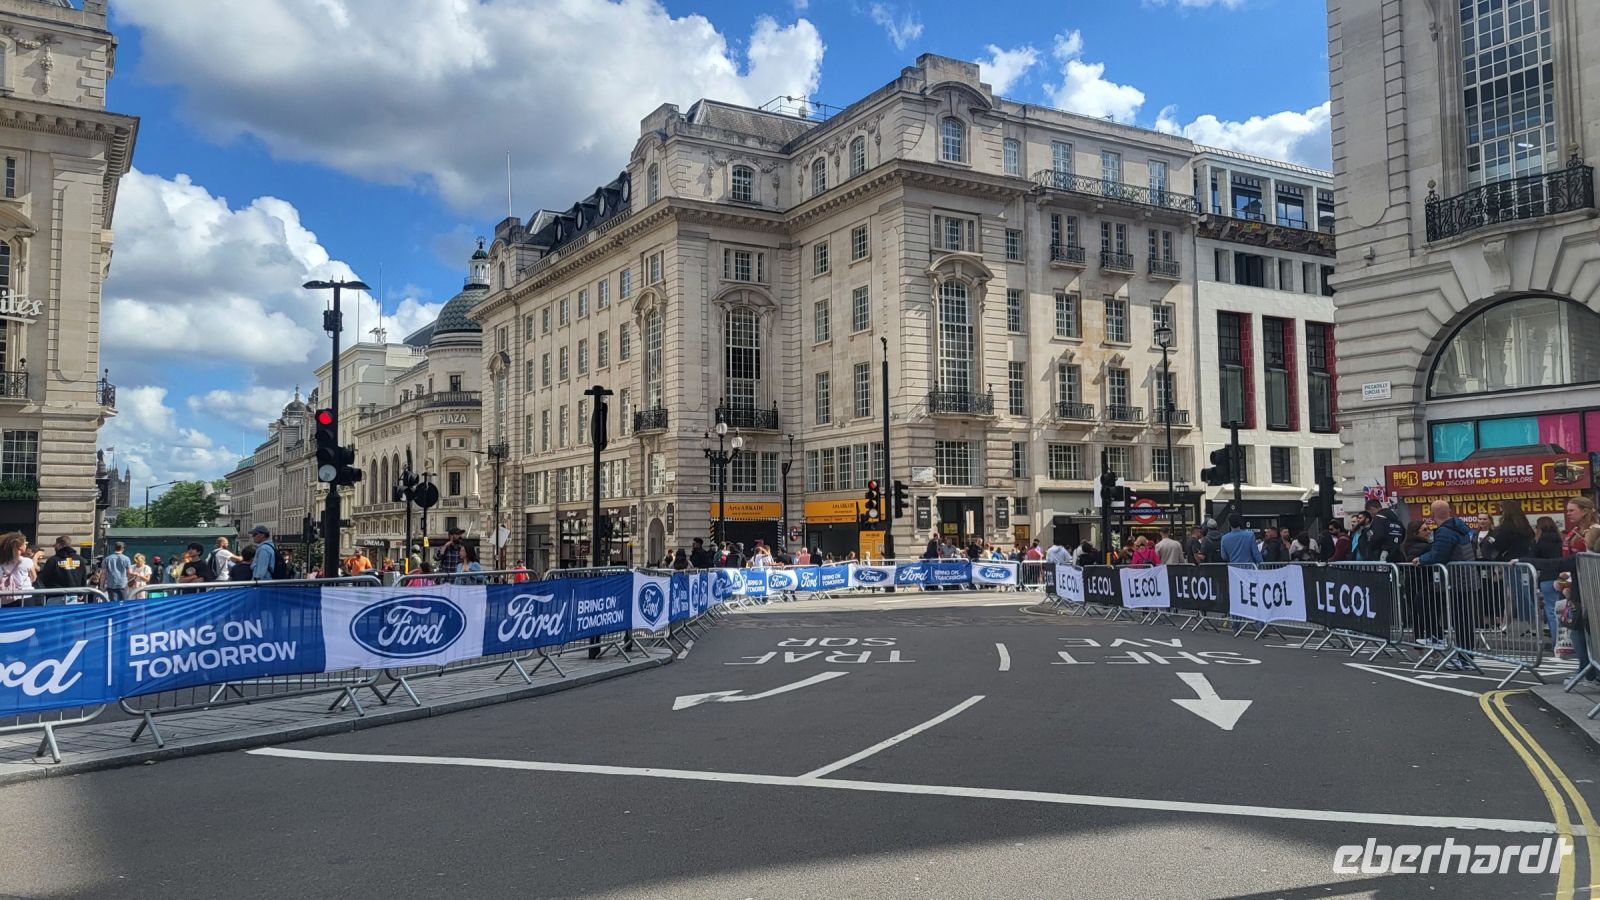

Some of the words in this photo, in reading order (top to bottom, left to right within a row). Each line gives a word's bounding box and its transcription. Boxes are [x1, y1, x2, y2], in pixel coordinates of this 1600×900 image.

[0, 289, 43, 316] ites
[439, 414, 467, 424] PLAZA
[1393, 471, 1407, 480] BIG
[1421, 470, 1444, 481] BUY
[1446, 467, 1497, 479] TICKETS
[1499, 465, 1534, 476] HERE
[1505, 476, 1534, 484] EXPLORE
[1453, 501, 1497, 515] TICKE
[1520, 499, 1565, 513] HERE
[770, 574, 788, 588] Ford
[800, 571, 818, 588] Ford
[860, 570, 882, 581] Ford
[900, 566, 928, 581] Ford
[985, 568, 1006, 578] Ford
[1059, 573, 1066, 590] LE
[1066, 574, 1079, 593] COL
[1088, 576, 1097, 594] LE
[1097, 576, 1114, 596] COL
[1128, 578, 1140, 598] LE
[1141, 577, 1161, 597] COL
[1175, 576, 1190, 599] LE
[1191, 576, 1216, 600] COL
[642, 588, 660, 618] Ford
[1240, 580, 1259, 608] LE
[1262, 580, 1293, 609] COL
[1316, 581, 1336, 613] LE
[1339, 583, 1376, 619] COL
[577, 597, 604, 615] BRING
[605, 596, 617, 610] ON
[378, 605, 447, 647] Ford
[498, 593, 567, 643] Ford
[577, 609, 625, 631] TOMORROW
[129, 624, 217, 656] BRING
[223, 619, 263, 642] ON
[777, 637, 898, 647] SQR
[1058, 638, 1183, 647] AVE
[0, 627, 89, 696] rd
[129, 641, 297, 682] TOMORROW
[723, 650, 916, 665] TRAF
[1050, 651, 1262, 665] SHFT
